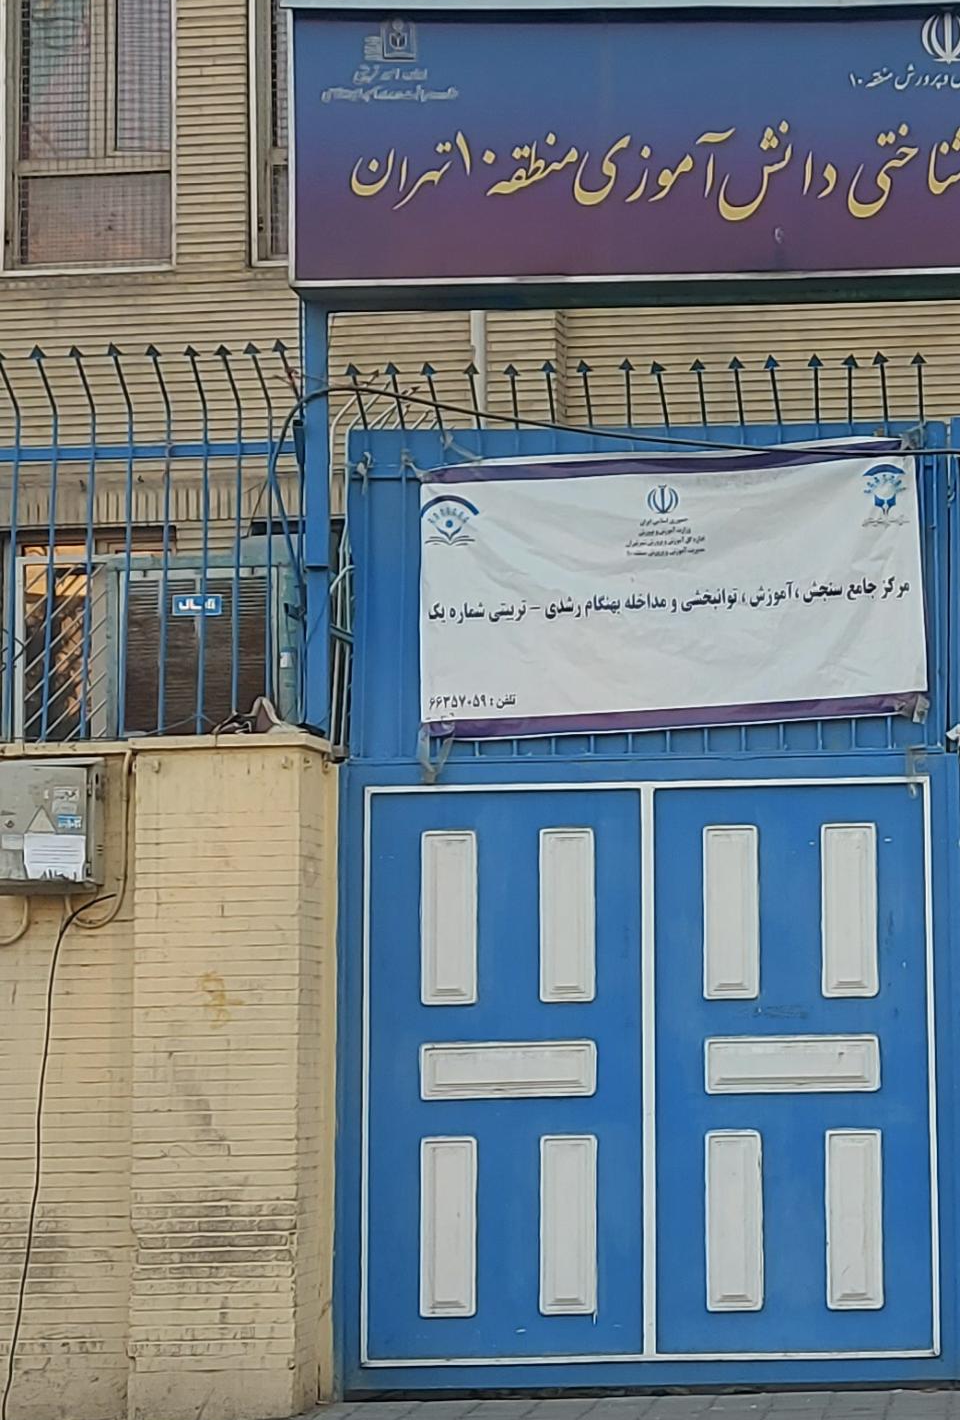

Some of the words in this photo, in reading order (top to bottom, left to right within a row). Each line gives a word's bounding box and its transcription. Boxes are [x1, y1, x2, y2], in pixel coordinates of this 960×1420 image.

[849, 73, 863, 87] ۱۰
[866, 67, 893, 88] منطقه
[455, 130, 497, 177] ۱۰
[486, 131, 580, 197] منطقه
[350, 140, 452, 211] تهران
[750, 582, 794, 607] آموزش
[803, 581, 843, 603] سنجش
[846, 578, 877, 600] جامع
[881, 576, 910, 598] مرکز
[544, 596, 581, 619] رشدی
[584, 594, 621, 616] بهنگام
[624, 593, 667, 609] مداخله
[671, 598, 677, 612] و
[681, 588, 737, 611] توانبخشی
[428, 603, 445, 623] یک
[450, 601, 485, 623] شماره
[488, 600, 527, 622] تربیتی
[496, 694, 516, 709] تلفن
